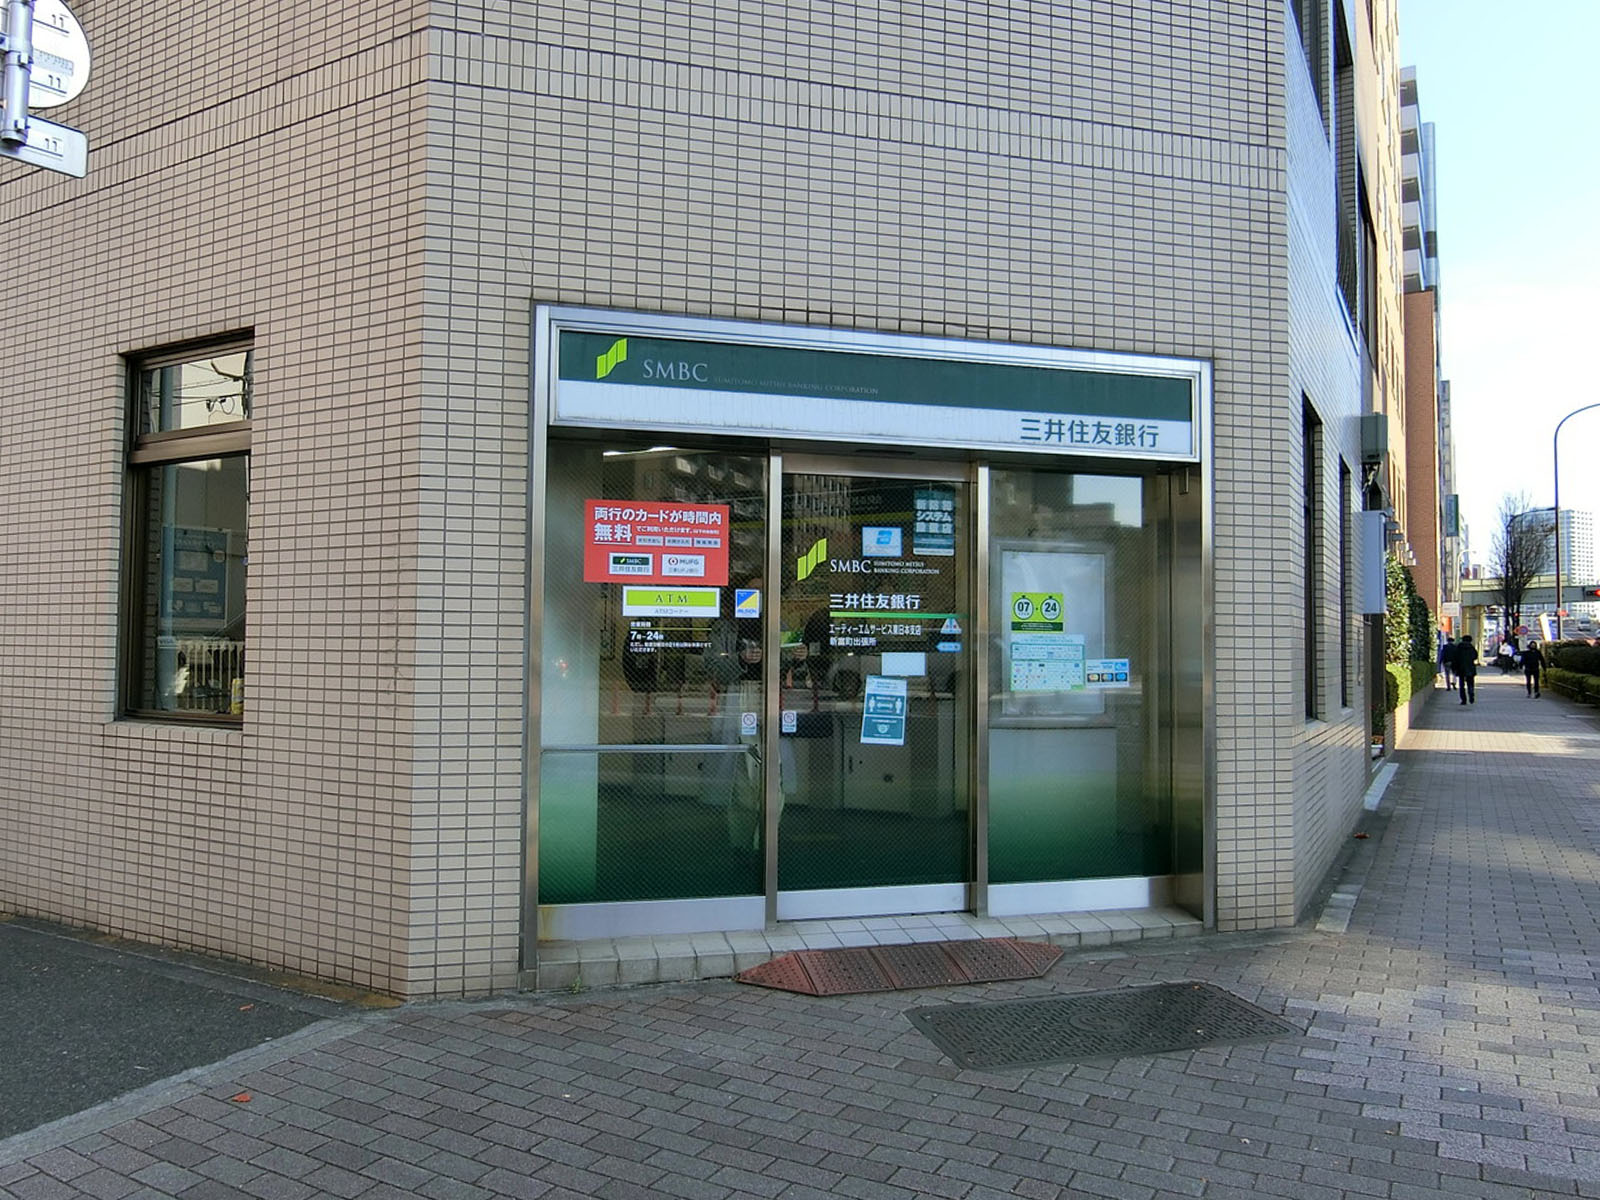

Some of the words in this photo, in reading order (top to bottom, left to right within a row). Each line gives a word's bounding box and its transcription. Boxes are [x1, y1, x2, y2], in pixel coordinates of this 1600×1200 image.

[642, 359, 708, 382] SMBC
[824, 384, 879, 395] CORPORATION
[1020, 418, 1159, 448] 三井住友銀行
[594, 506, 722, 525] 両行のカードが時間内
[916, 510, 952, 521] システム
[594, 523, 632, 542] 無料
[830, 559, 871, 573] SMBC
[655, 594, 688, 604] ATM
[829, 594, 921, 609] 三井住友銀行
[1017, 602, 1030, 612] 07
[1044, 602, 1057, 613] 24
[829, 624, 922, 636] エーティーエムサービス東日本支店
